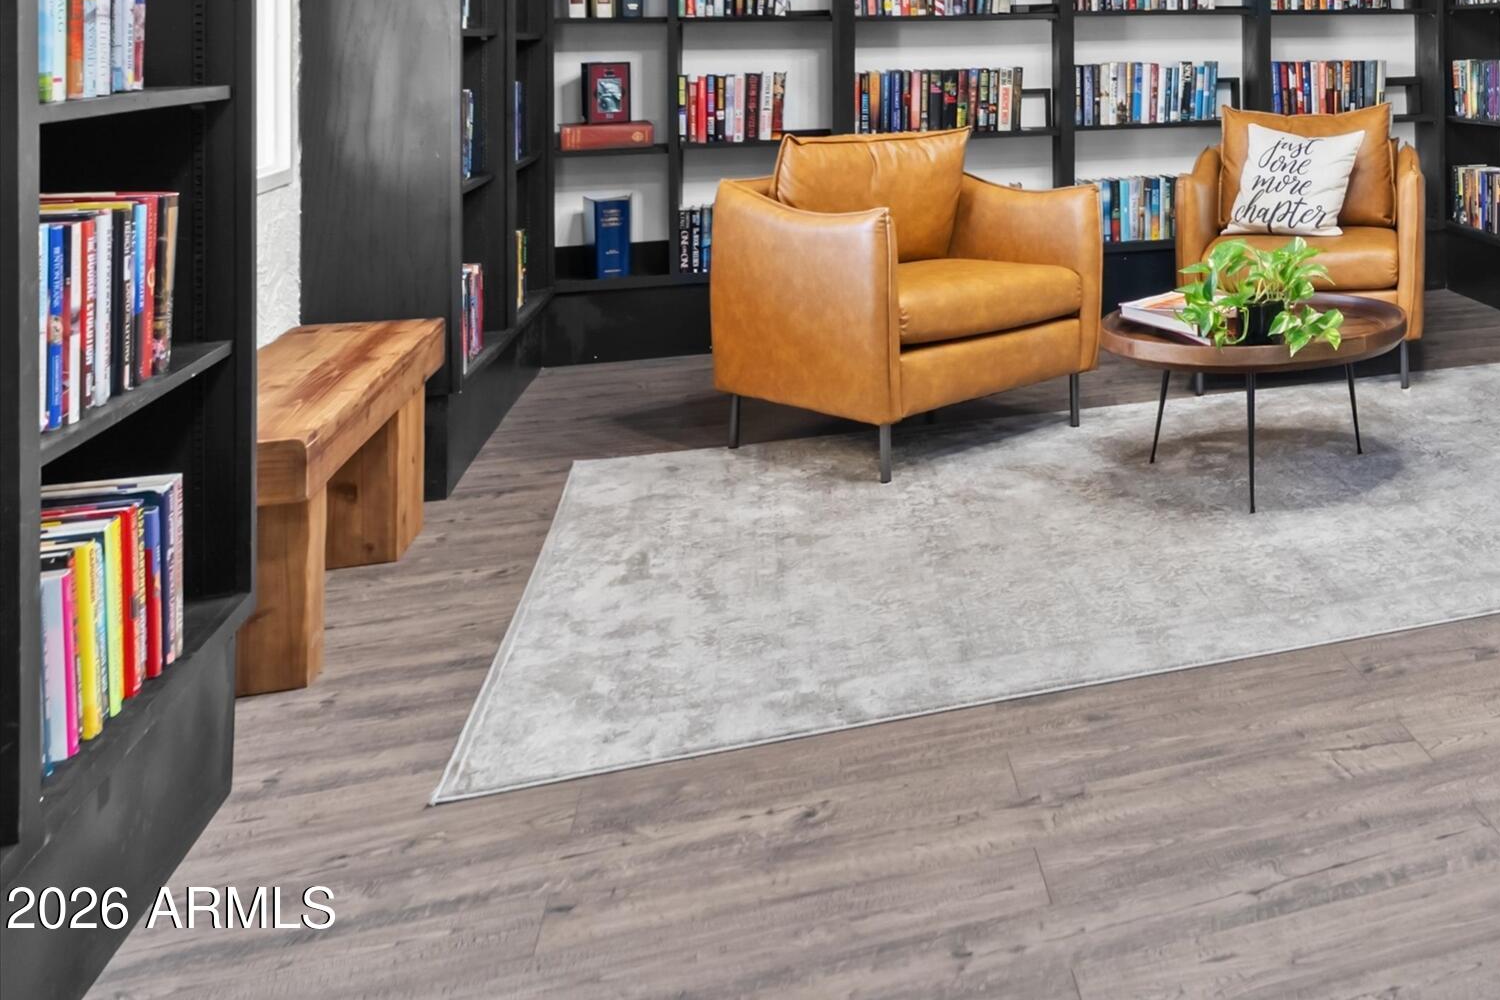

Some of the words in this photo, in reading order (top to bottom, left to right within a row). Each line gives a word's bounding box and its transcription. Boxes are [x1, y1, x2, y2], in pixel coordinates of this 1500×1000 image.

[1259, 137, 1324, 168] just
[1270, 155, 1312, 175] one
[1252, 175, 1312, 195] more
[1235, 189, 1327, 233] chapter
[86, 254, 94, 300] BOURNE
[86, 303, 94, 366] EVOLUTION
[138, 541, 146, 604] GARDNER
